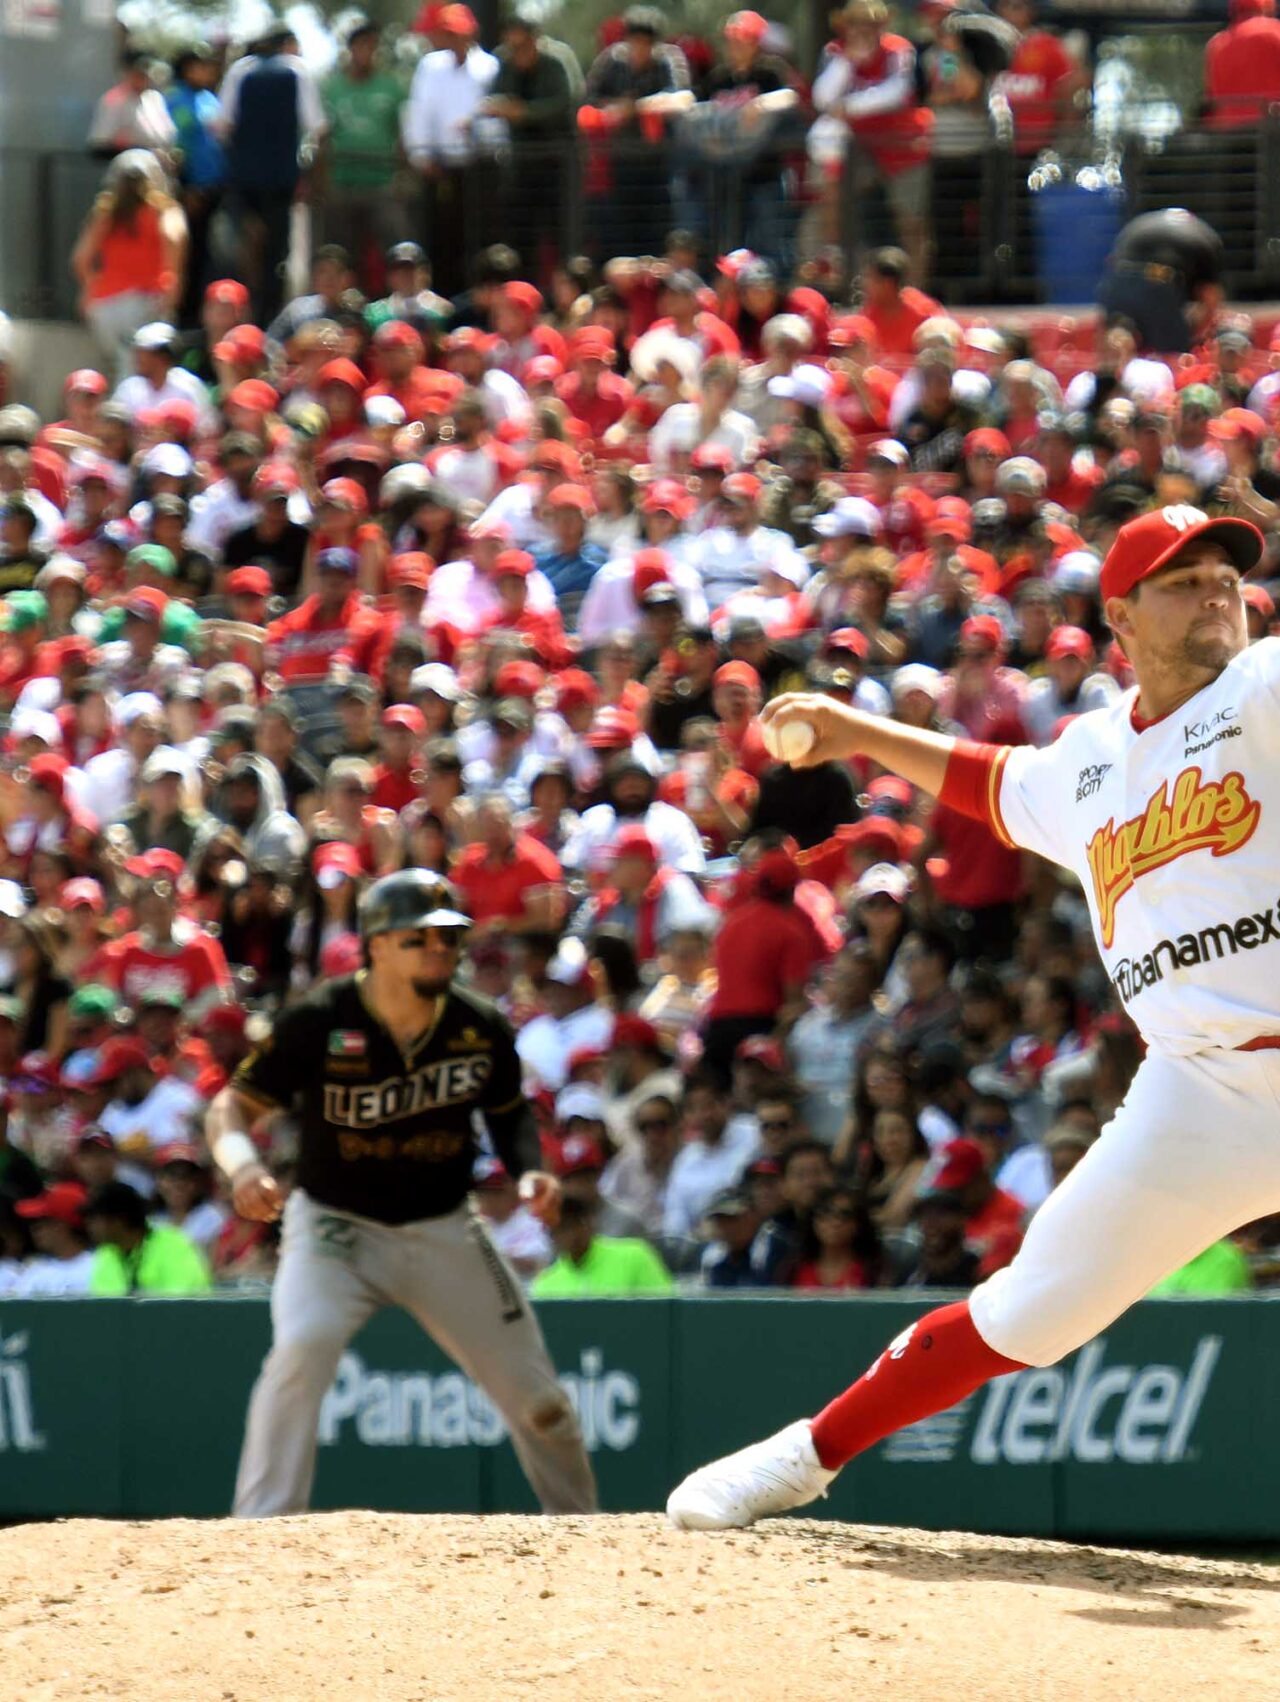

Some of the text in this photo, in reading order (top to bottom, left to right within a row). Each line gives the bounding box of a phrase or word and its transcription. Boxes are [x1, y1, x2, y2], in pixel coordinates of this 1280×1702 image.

[1086, 765, 1261, 950] Diablos
[323, 1053, 493, 1128] LEONES
[316, 1348, 638, 1451] Panasic
